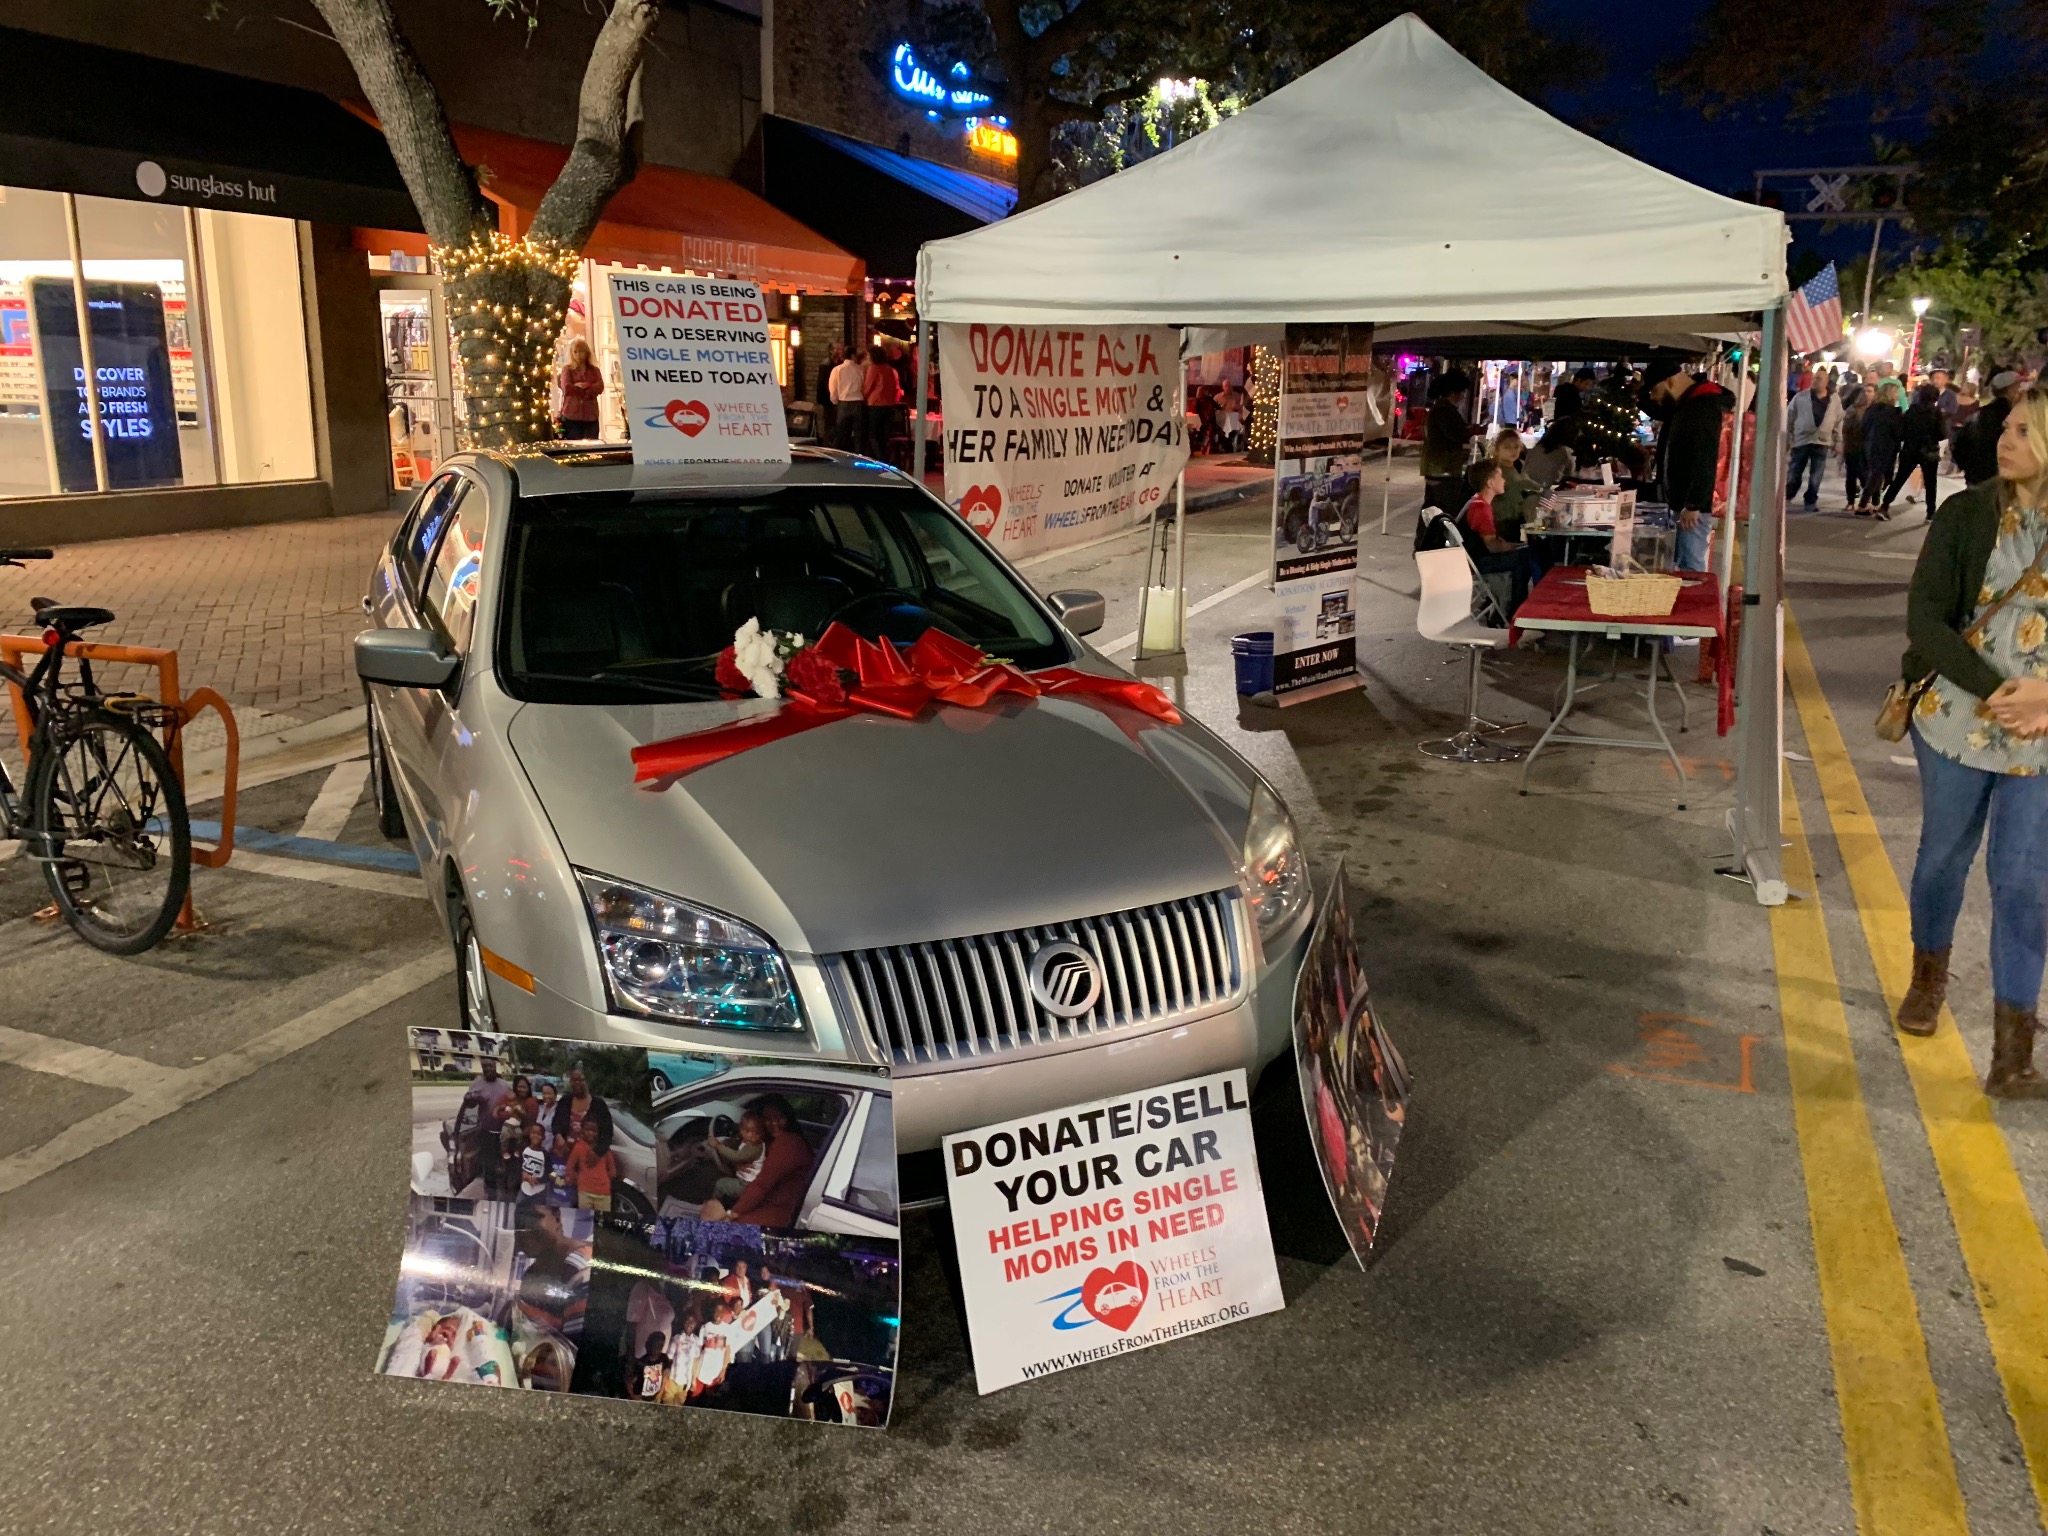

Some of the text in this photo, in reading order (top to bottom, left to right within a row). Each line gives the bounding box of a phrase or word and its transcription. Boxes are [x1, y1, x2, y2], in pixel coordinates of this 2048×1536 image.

[171, 173, 277, 203] sunglass hut
[613, 279, 756, 298] THIS CAR IS BEING
[618, 296, 763, 323] DONATED
[623, 326, 647, 339] TO
[654, 327, 667, 339] A
[673, 328, 767, 343] DESERVING
[626, 347, 770, 364] SINGLE MOTHER
[970, 323, 1084, 377] DONATE
[73, 367, 145, 381] DCOVER
[631, 369, 773, 385] IN NEED TODAY!
[76, 386, 147, 398] TO BRANDS
[974, 384, 1003, 418] TO
[1010, 386, 1024, 418] A
[1024, 386, 1090, 419] SINGLE
[1147, 384, 1164, 412] &
[79, 401, 148, 414] AD FRESH
[714, 402, 769, 414] WHEELS
[80, 418, 152, 439] SYLES
[719, 422, 772, 436] HEART
[947, 429, 996, 463] HER
[1003, 427, 1068, 462] FAMILY
[1075, 427, 1093, 456] IN
[1007, 484, 1044, 502] WHEELS
[1063, 475, 1102, 497] DONATE
[1002, 515, 1038, 541] HEART
[1295, 648, 1339, 669] ENTER NOW
[952, 1081, 1247, 1177] DONATE/SELL
[994, 1129, 1222, 1212] YOUR CAR
[988, 1168, 1238, 1253] HELPING SINGLE
[1004, 1203, 1225, 1282] MOMS IN NEED
[1150, 1246, 1217, 1275] WHEELS
[1154, 1263, 1220, 1290] FROM THE
[1158, 1277, 1224, 1312] HEART
